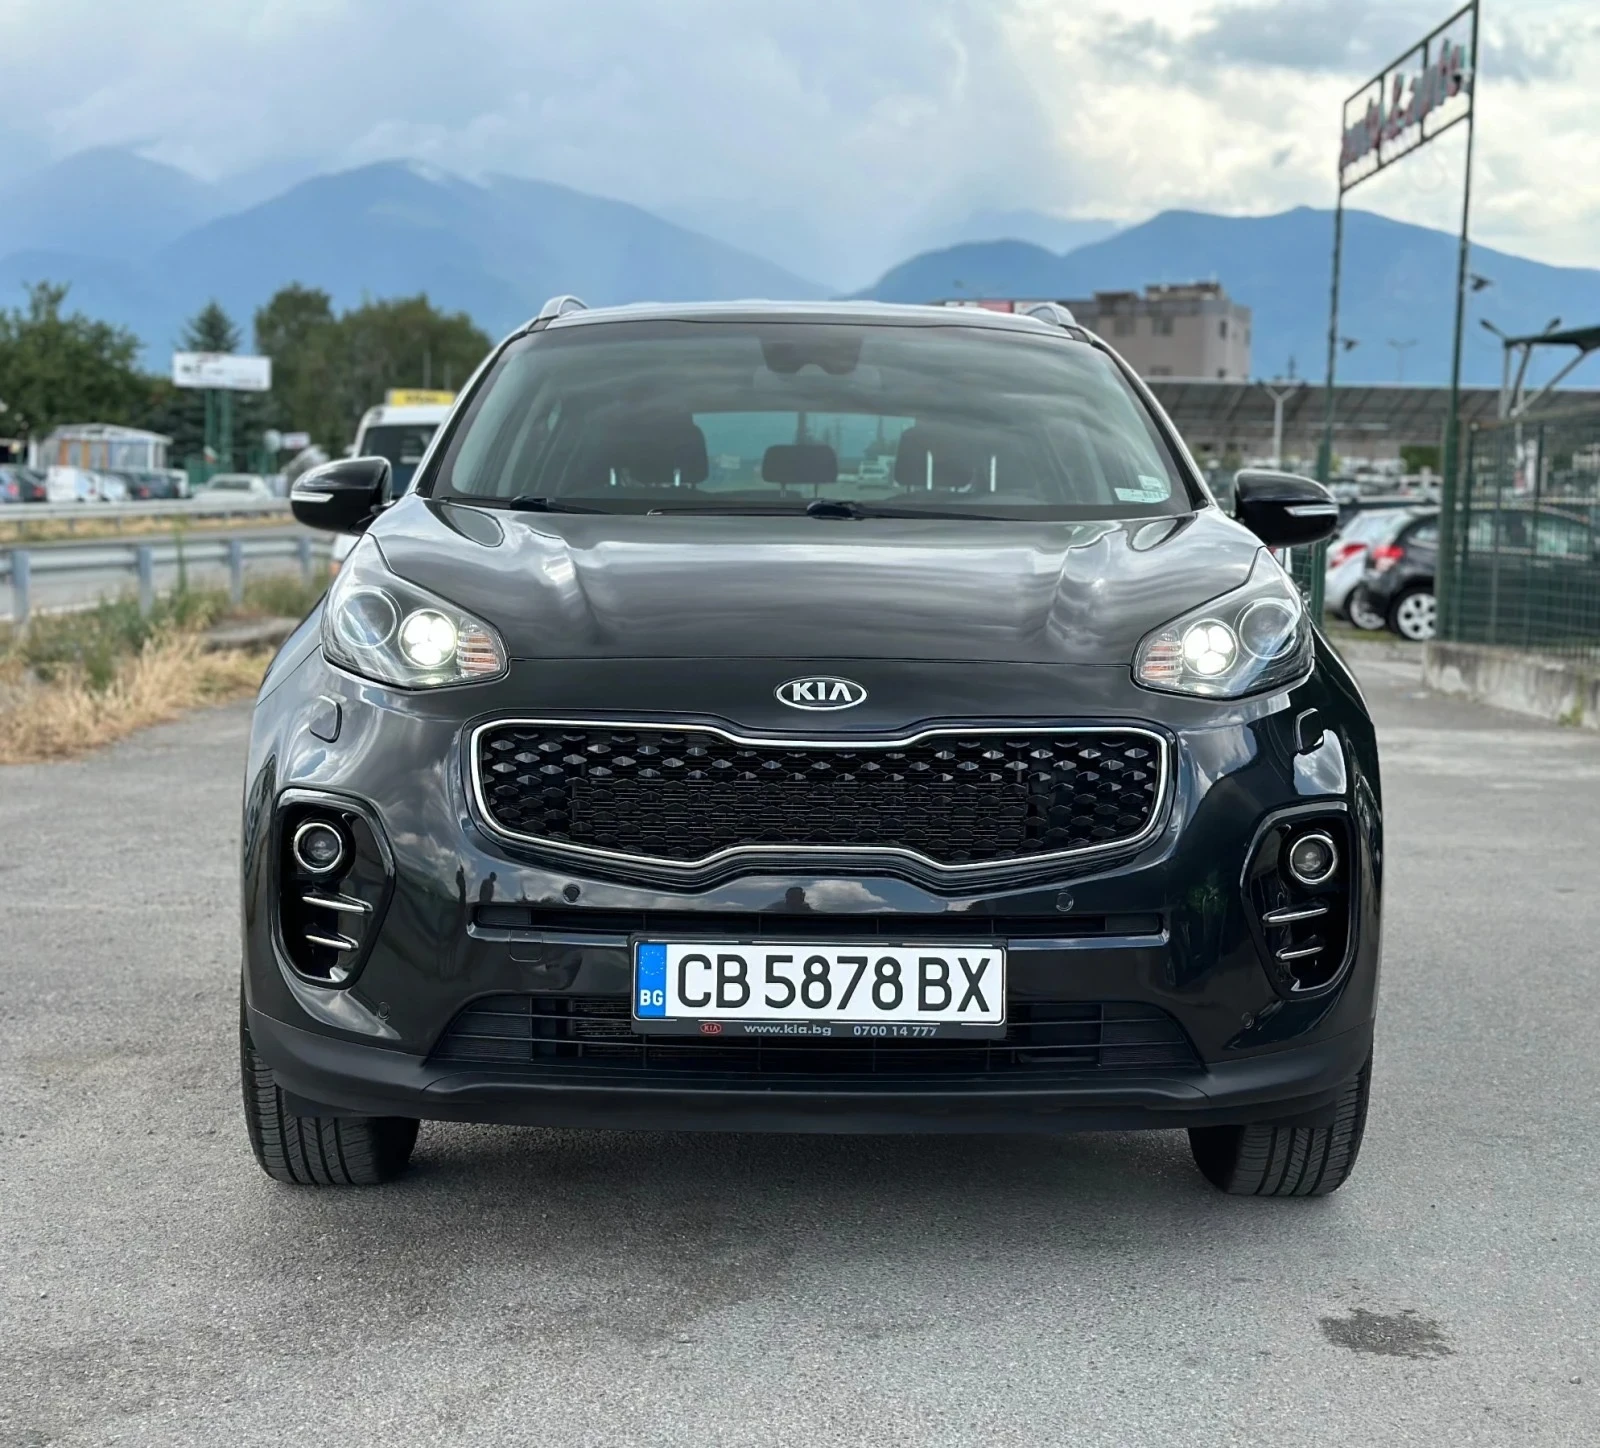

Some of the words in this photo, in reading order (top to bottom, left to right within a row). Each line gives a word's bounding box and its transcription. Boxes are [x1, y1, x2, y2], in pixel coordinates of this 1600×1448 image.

[792, 682, 853, 702] KIA
[677, 953, 751, 1009] CB
[765, 954, 904, 1011] 5878
[917, 956, 991, 1013] BX
[640, 989, 664, 1006] BG
[744, 1024, 832, 1036] www.kia.bg
[853, 1025, 887, 1036] 0700
[892, 1026, 908, 1036] 14
[912, 1026, 937, 1037] 777
